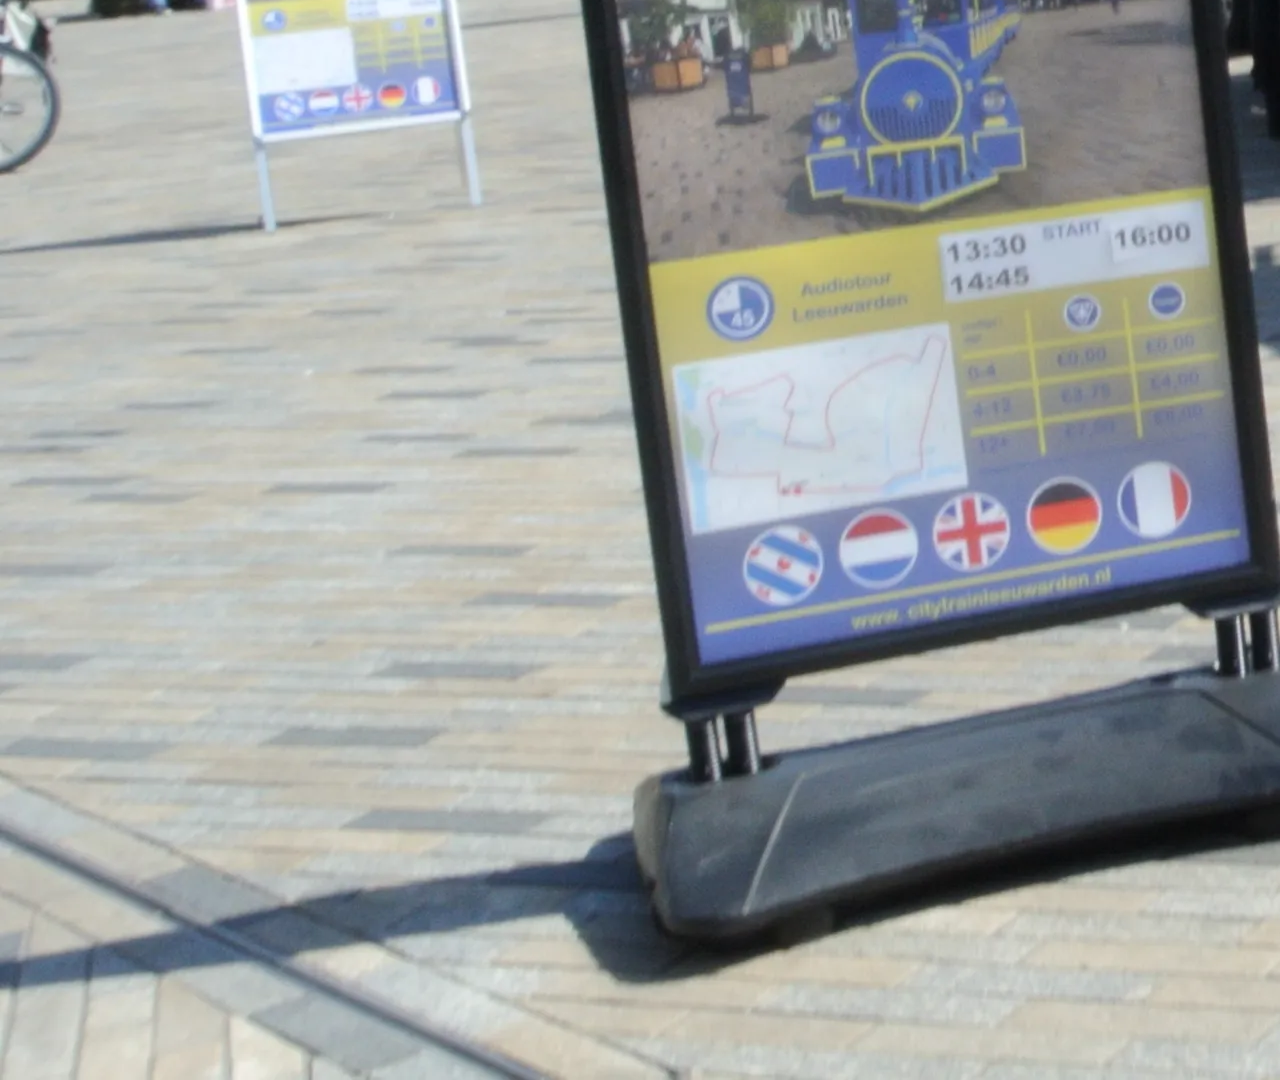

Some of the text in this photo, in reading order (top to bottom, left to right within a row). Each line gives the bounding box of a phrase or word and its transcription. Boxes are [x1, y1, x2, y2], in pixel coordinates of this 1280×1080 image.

[946, 218, 1192, 264] 13:30 START 16:00
[801, 272, 892, 298] Audiotour
[949, 265, 1031, 296] 14:45
[791, 294, 909, 323] Leeuwarden
